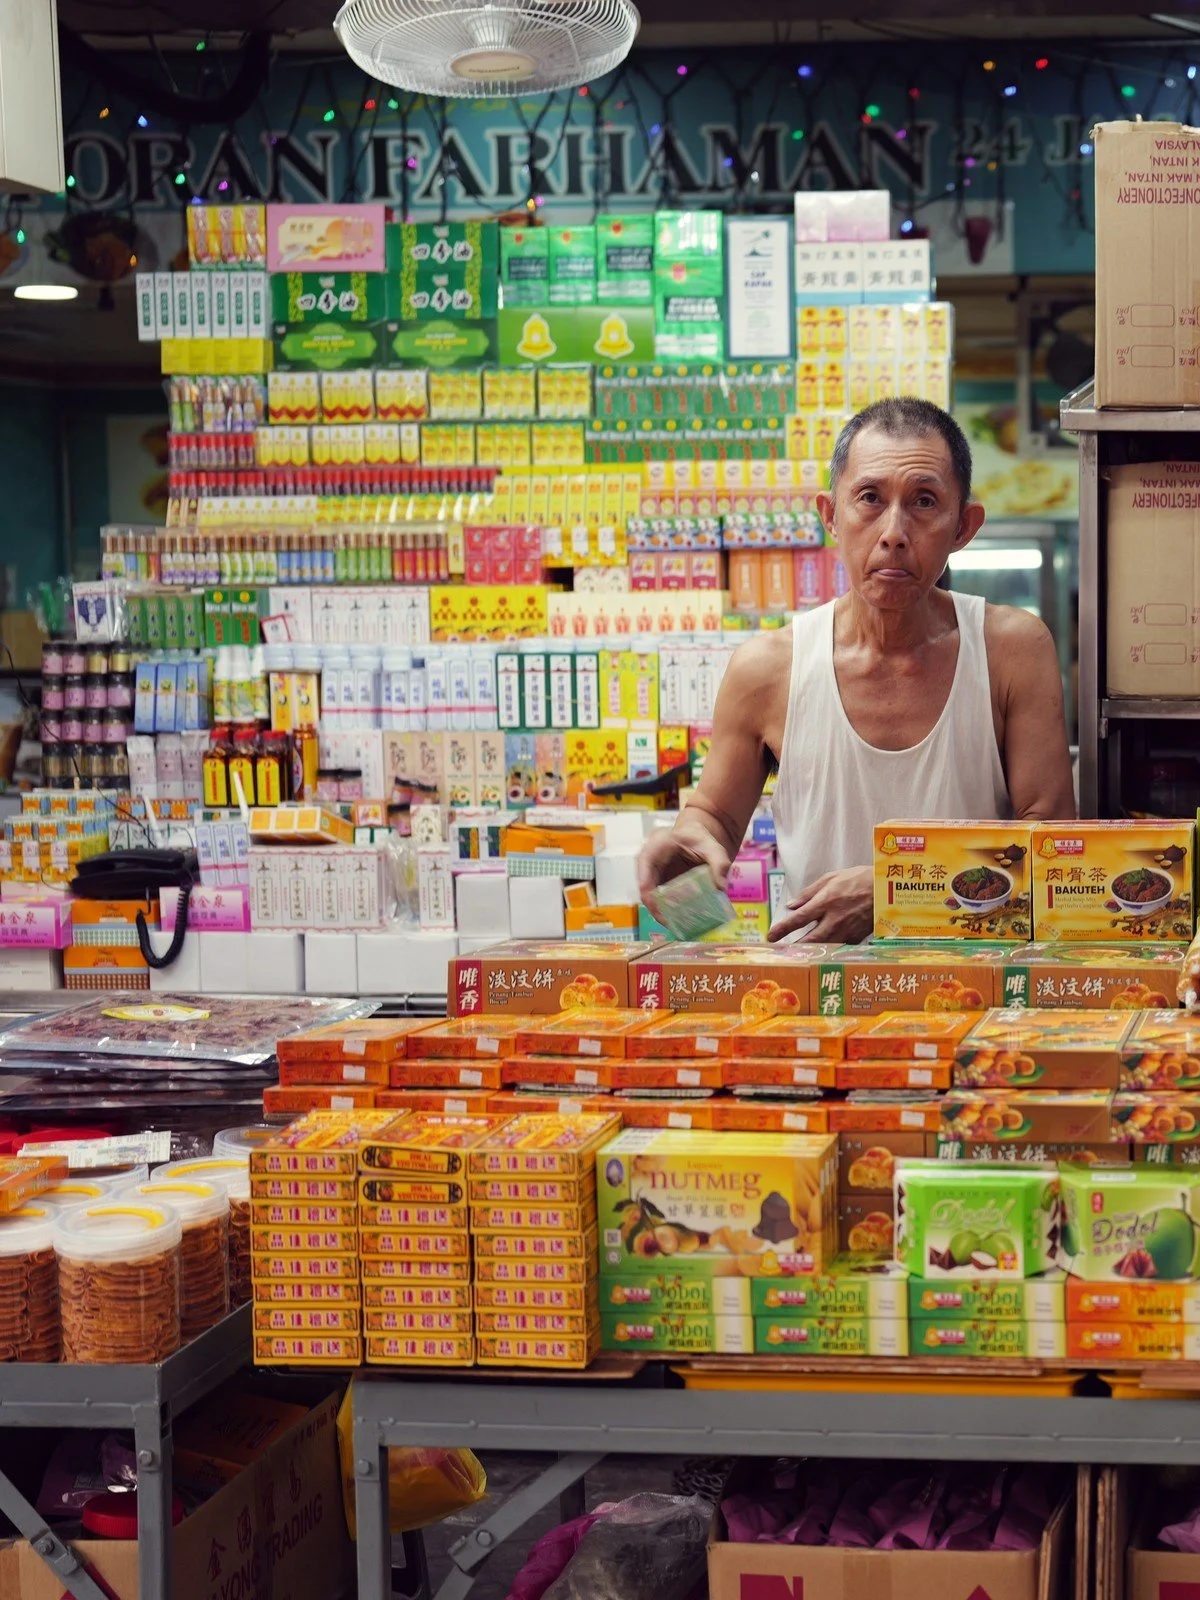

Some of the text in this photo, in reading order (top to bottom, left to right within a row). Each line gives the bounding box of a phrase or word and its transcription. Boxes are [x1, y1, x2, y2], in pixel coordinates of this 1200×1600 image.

[362, 118, 938, 202] FARHAMAN
[1149, 156, 1188, 166] INTAN,
[1125, 172, 1164, 182] INTAN,
[1168, 173, 1192, 182] MAK
[1116, 306, 1130, 316] pkt
[1116, 347, 1130, 357] pkt
[1163, 462, 1200, 473] INTAN,
[1140, 478, 1176, 488] INTAN,
[886, 864, 948, 880] 肉骨茶
[1045, 867, 1108, 883] 肉骨茶
[895, 882, 945, 891] BAKUTEH
[1055, 886, 1105, 894] BAKUTEH
[488, 969, 555, 990] 淡汶饼
[669, 973, 737, 995] 淡汶饼
[851, 973, 919, 995] 淡汶饼
[1036, 977, 1105, 998] 淡汶饼
[1092, 1212, 1158, 1243] Dodol
[264, 1492, 323, 1570] TRADING
